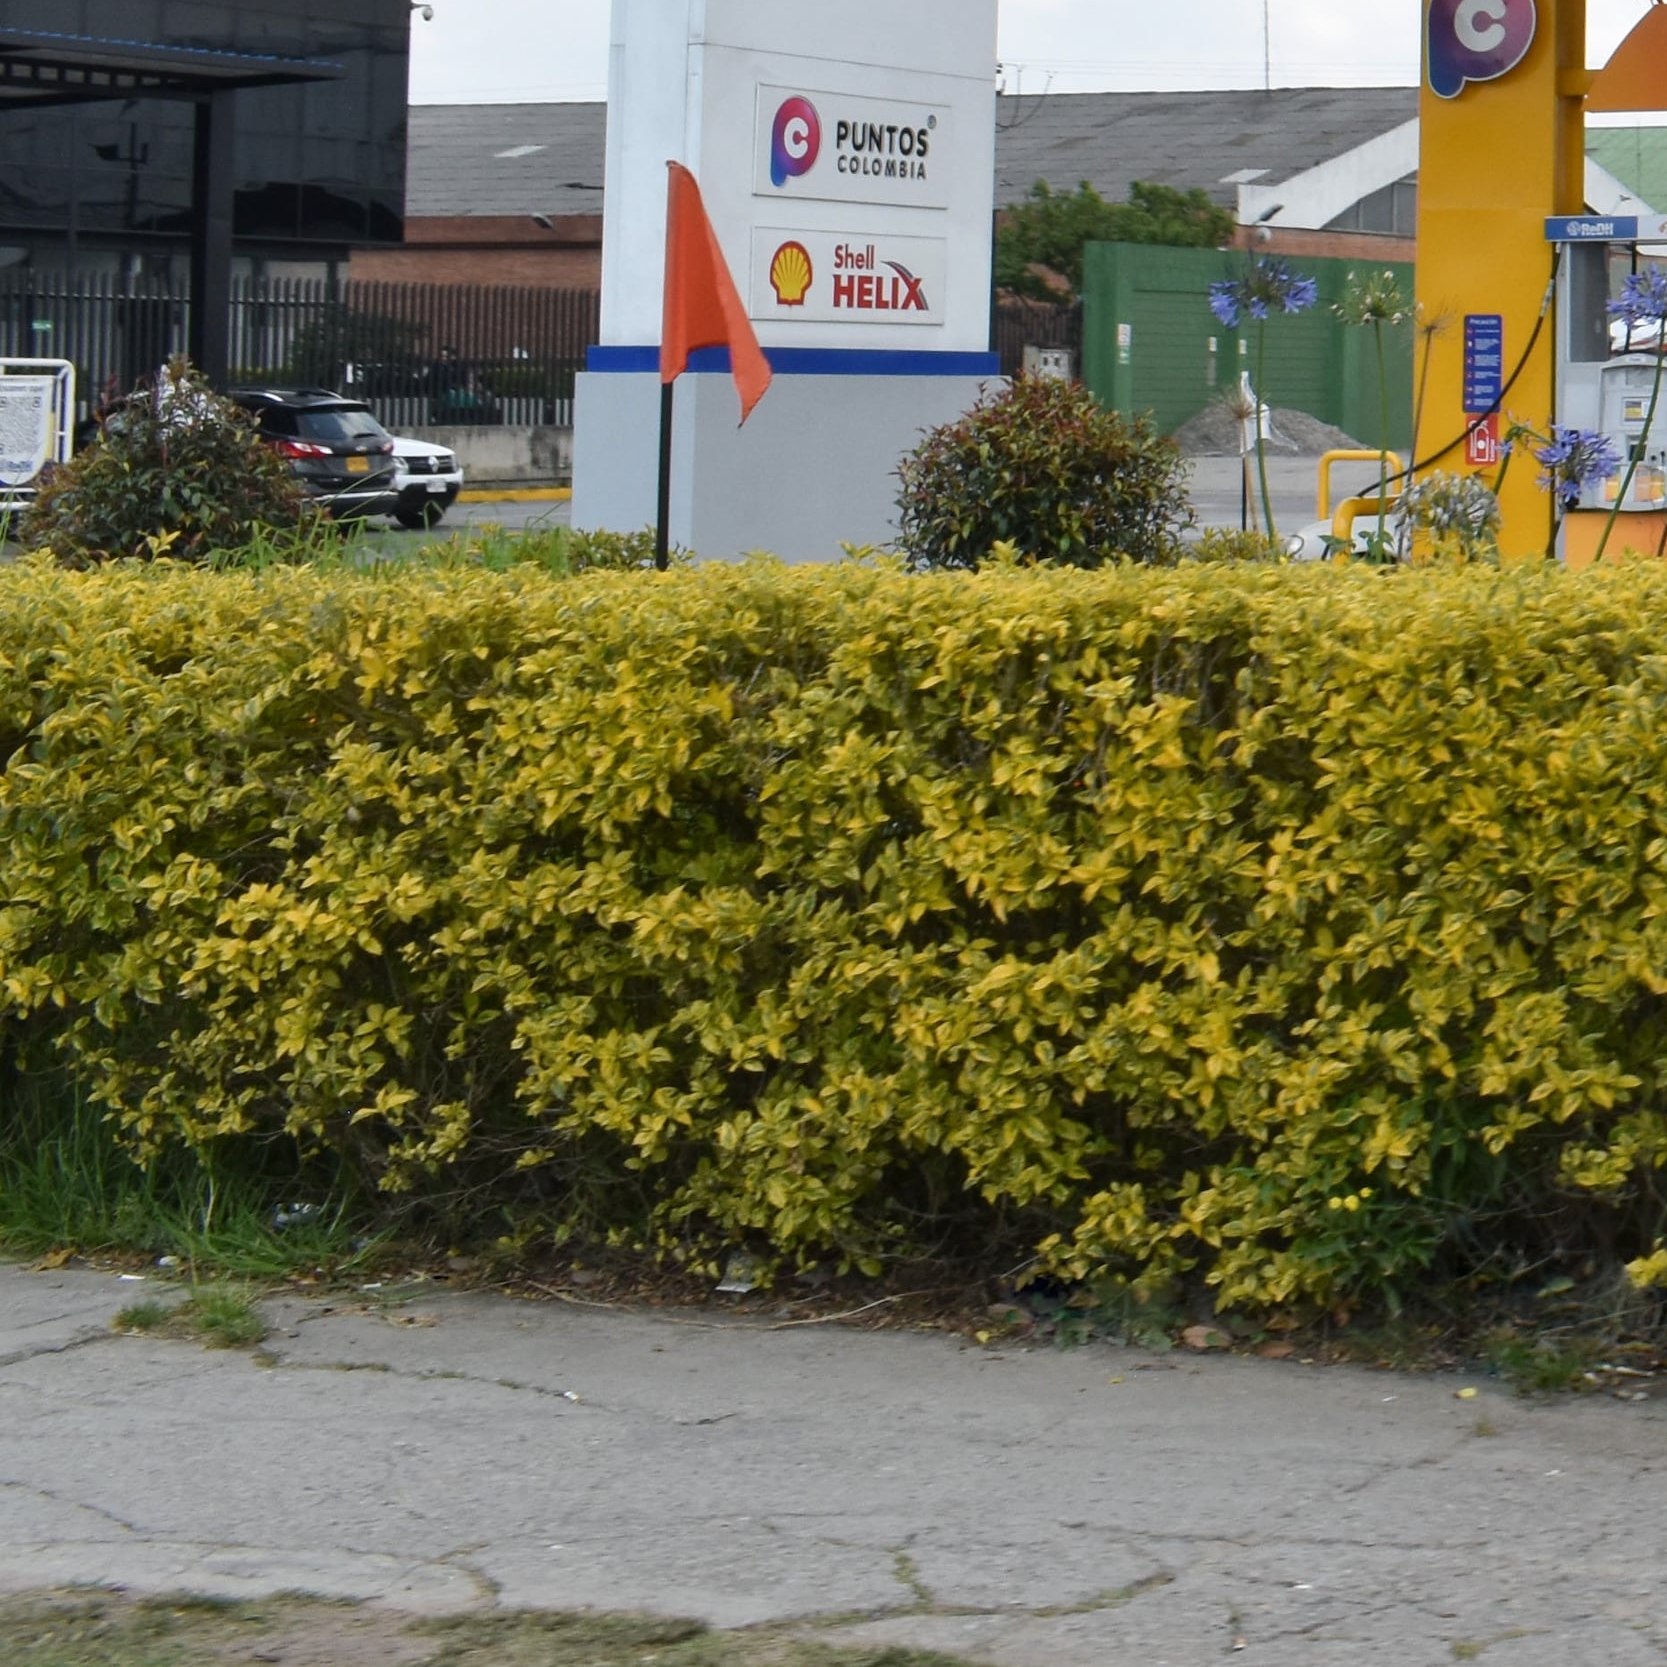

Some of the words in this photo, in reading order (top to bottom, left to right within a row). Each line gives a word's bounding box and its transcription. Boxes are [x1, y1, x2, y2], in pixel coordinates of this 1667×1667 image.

[836, 120, 929, 157] PUNTOS
[837, 155, 927, 180] COLOMBIA
[834, 243, 875, 270] Shell
[833, 269, 929, 311] HELIX
